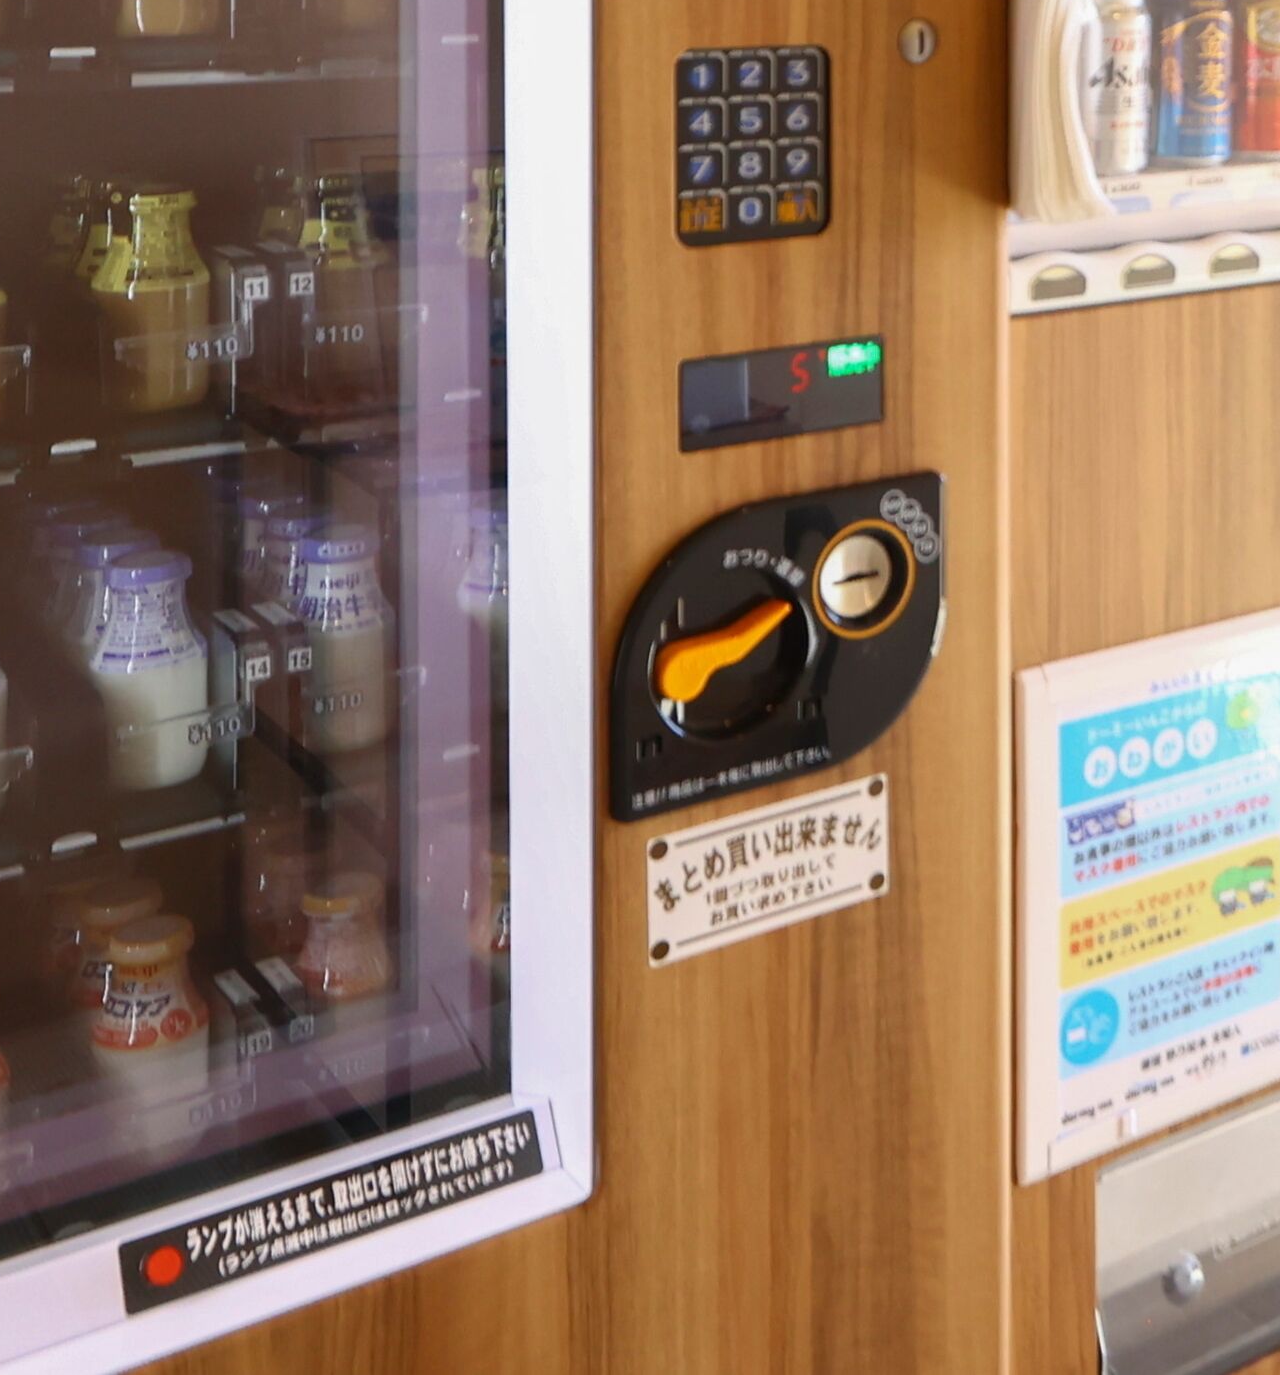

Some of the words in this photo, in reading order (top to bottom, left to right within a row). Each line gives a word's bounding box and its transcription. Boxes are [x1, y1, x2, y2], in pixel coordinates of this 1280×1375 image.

[693, 63, 709, 90] 1
[740, 60, 763, 87] 2
[787, 59, 810, 86] 3
[689, 110, 712, 136] 4
[740, 106, 762, 133] 5
[786, 105, 809, 130] 6
[690, 155, 713, 182] 7
[739, 151, 762, 178] 8
[786, 148, 809, 175] 9
[739, 197, 762, 224] 0
[249, 281, 265, 297] 11
[293, 277, 312, 294] 12
[315, 324, 364, 343] ¥110
[186, 337, 239, 360] ¥110
[249, 660, 269, 678] 14
[290, 650, 311, 667] 15
[314, 692, 363, 714] ¥110
[188, 716, 241, 744] ¥110
[654, 812, 881, 912] まとめ買い出来ません
